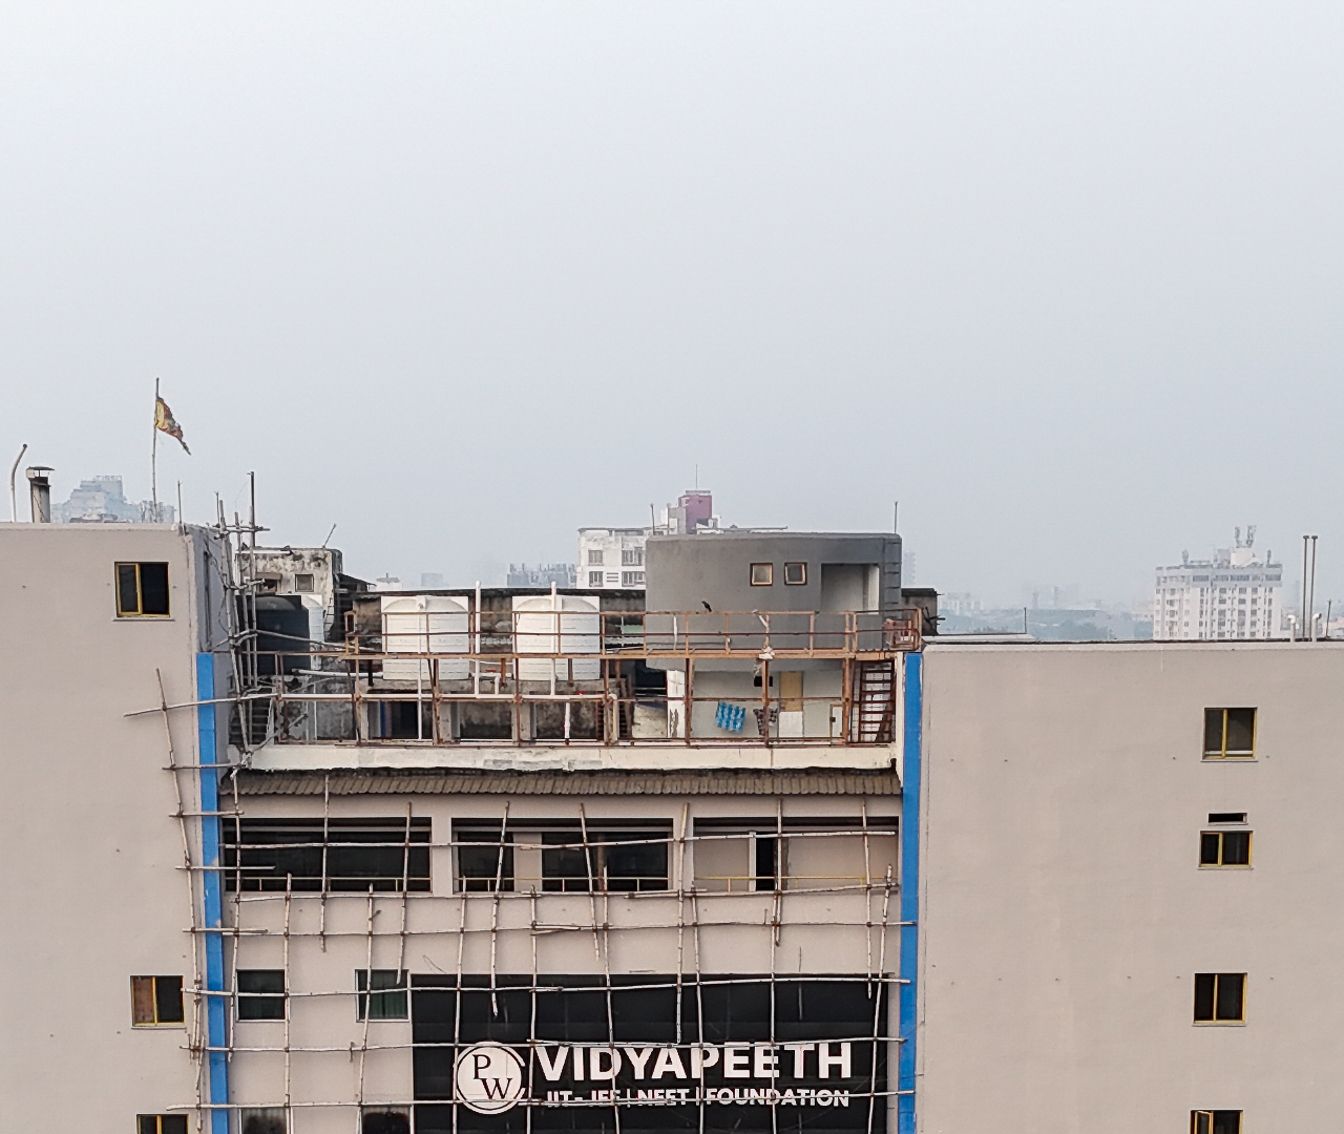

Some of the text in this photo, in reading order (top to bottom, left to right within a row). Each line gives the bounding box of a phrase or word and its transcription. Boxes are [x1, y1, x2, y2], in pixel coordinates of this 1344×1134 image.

[472, 1053, 513, 1100] PW
[534, 1041, 851, 1081] VIDYAPEETH
[637, 1088, 690, 1106] NEET
[706, 1087, 849, 1108] FOUNDATION
